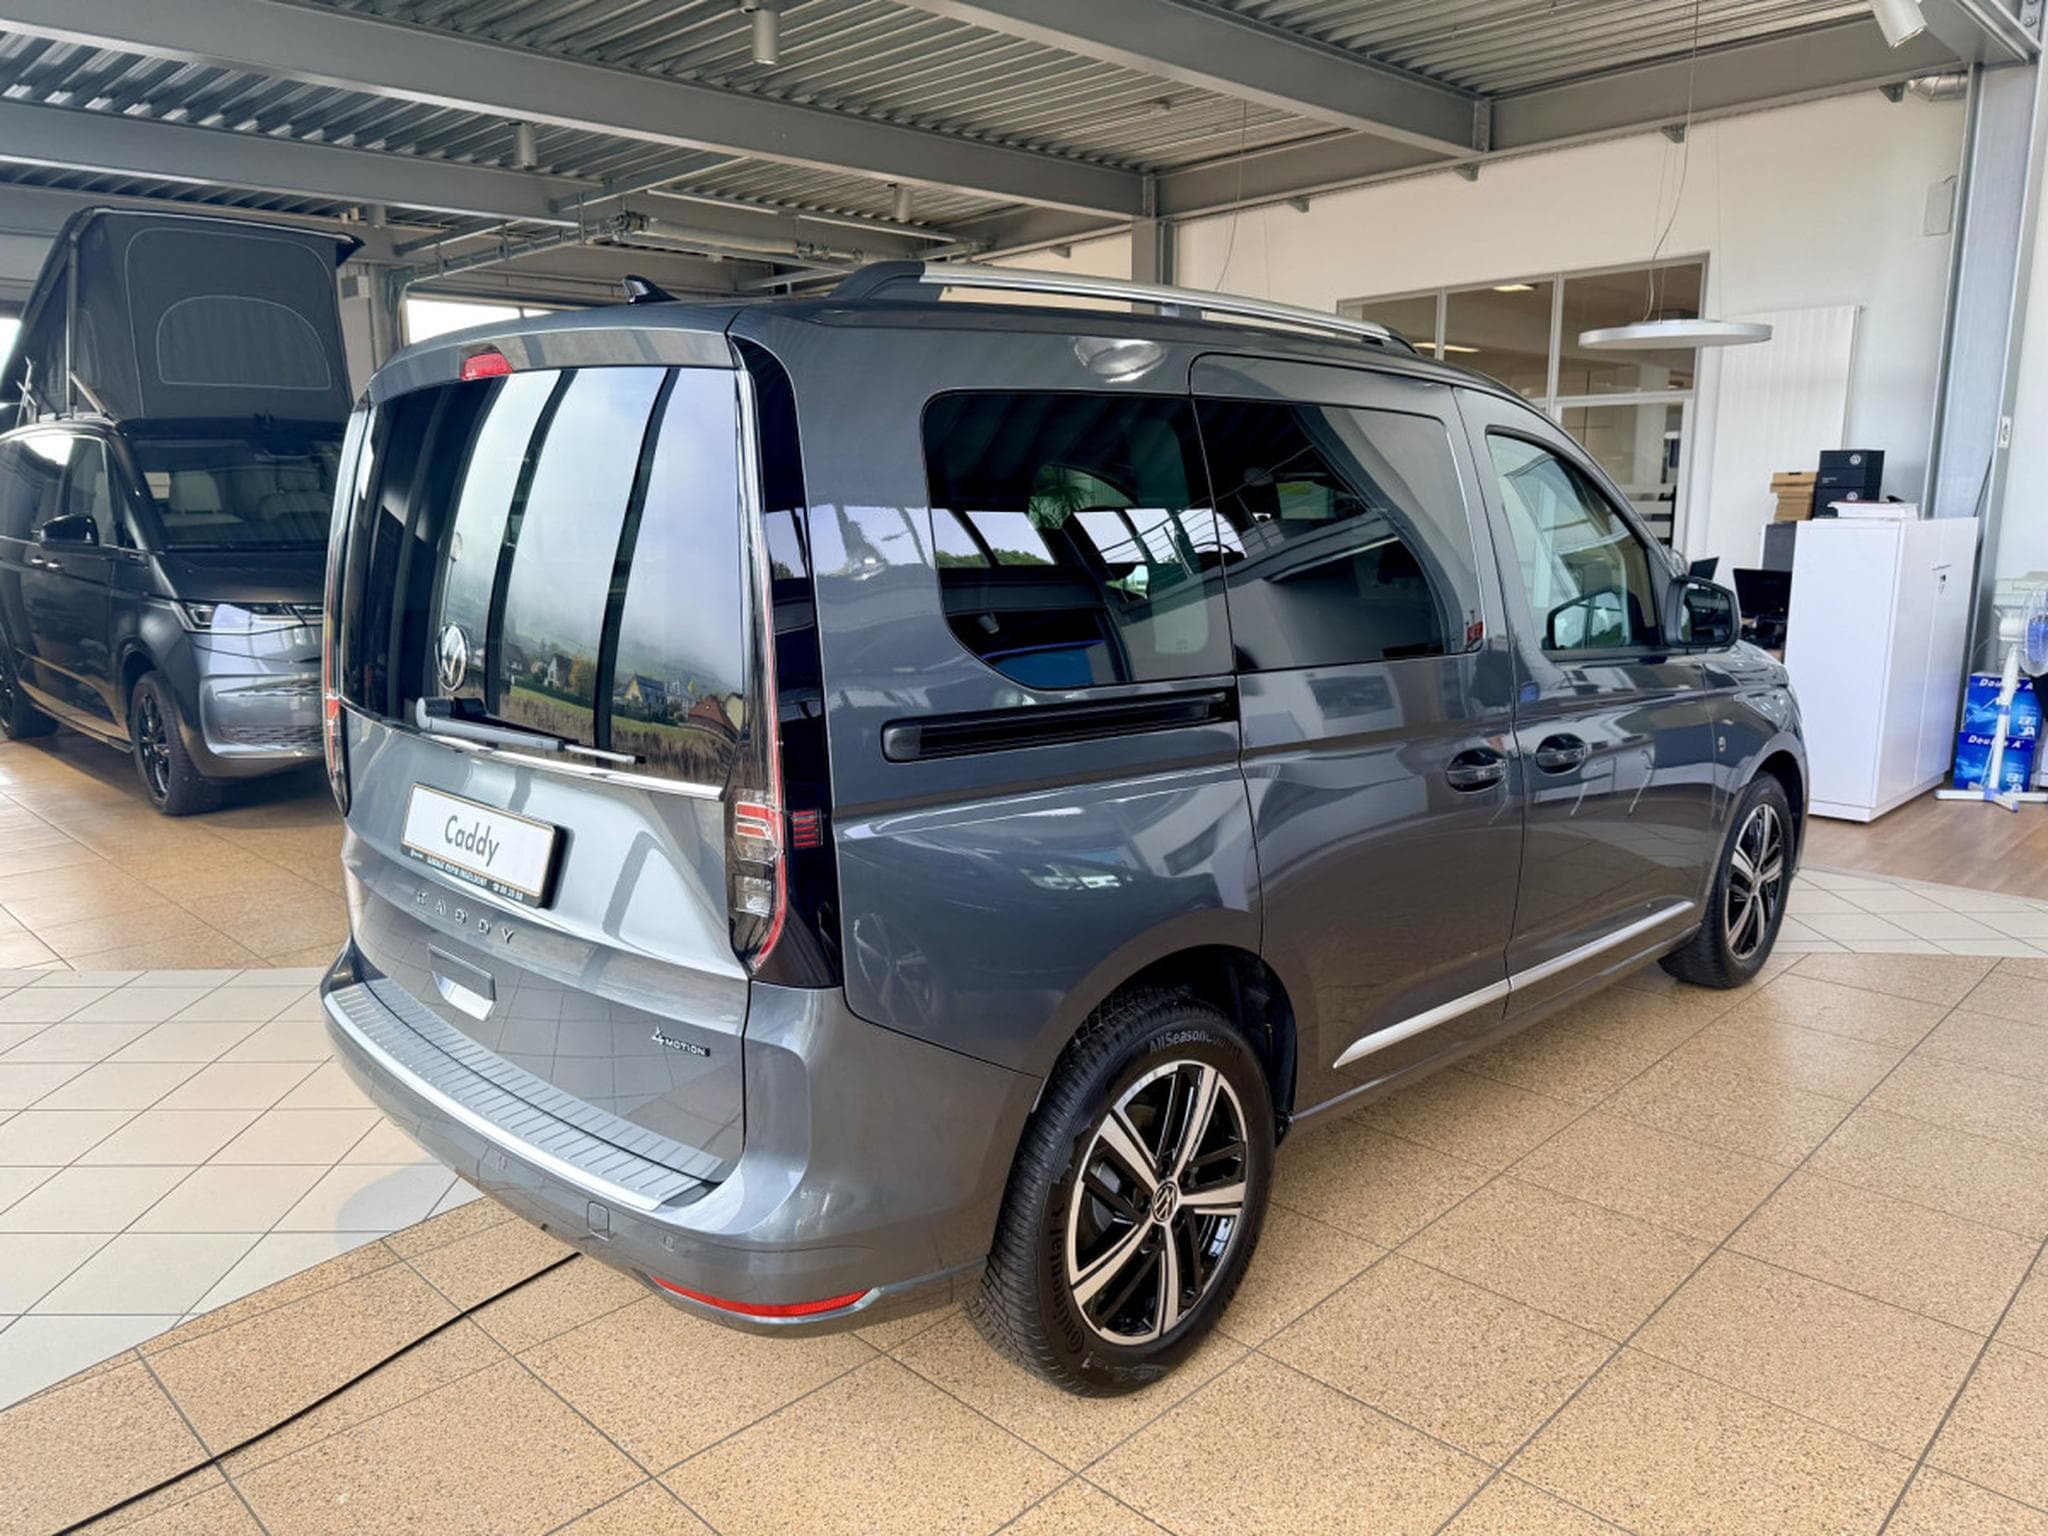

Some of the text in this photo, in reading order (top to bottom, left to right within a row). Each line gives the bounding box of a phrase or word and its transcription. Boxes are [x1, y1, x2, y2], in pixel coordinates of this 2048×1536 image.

[444, 815, 500, 867] Caddy
[416, 890, 514, 944] CADDY
[651, 1026, 708, 1056] 4MOTION
